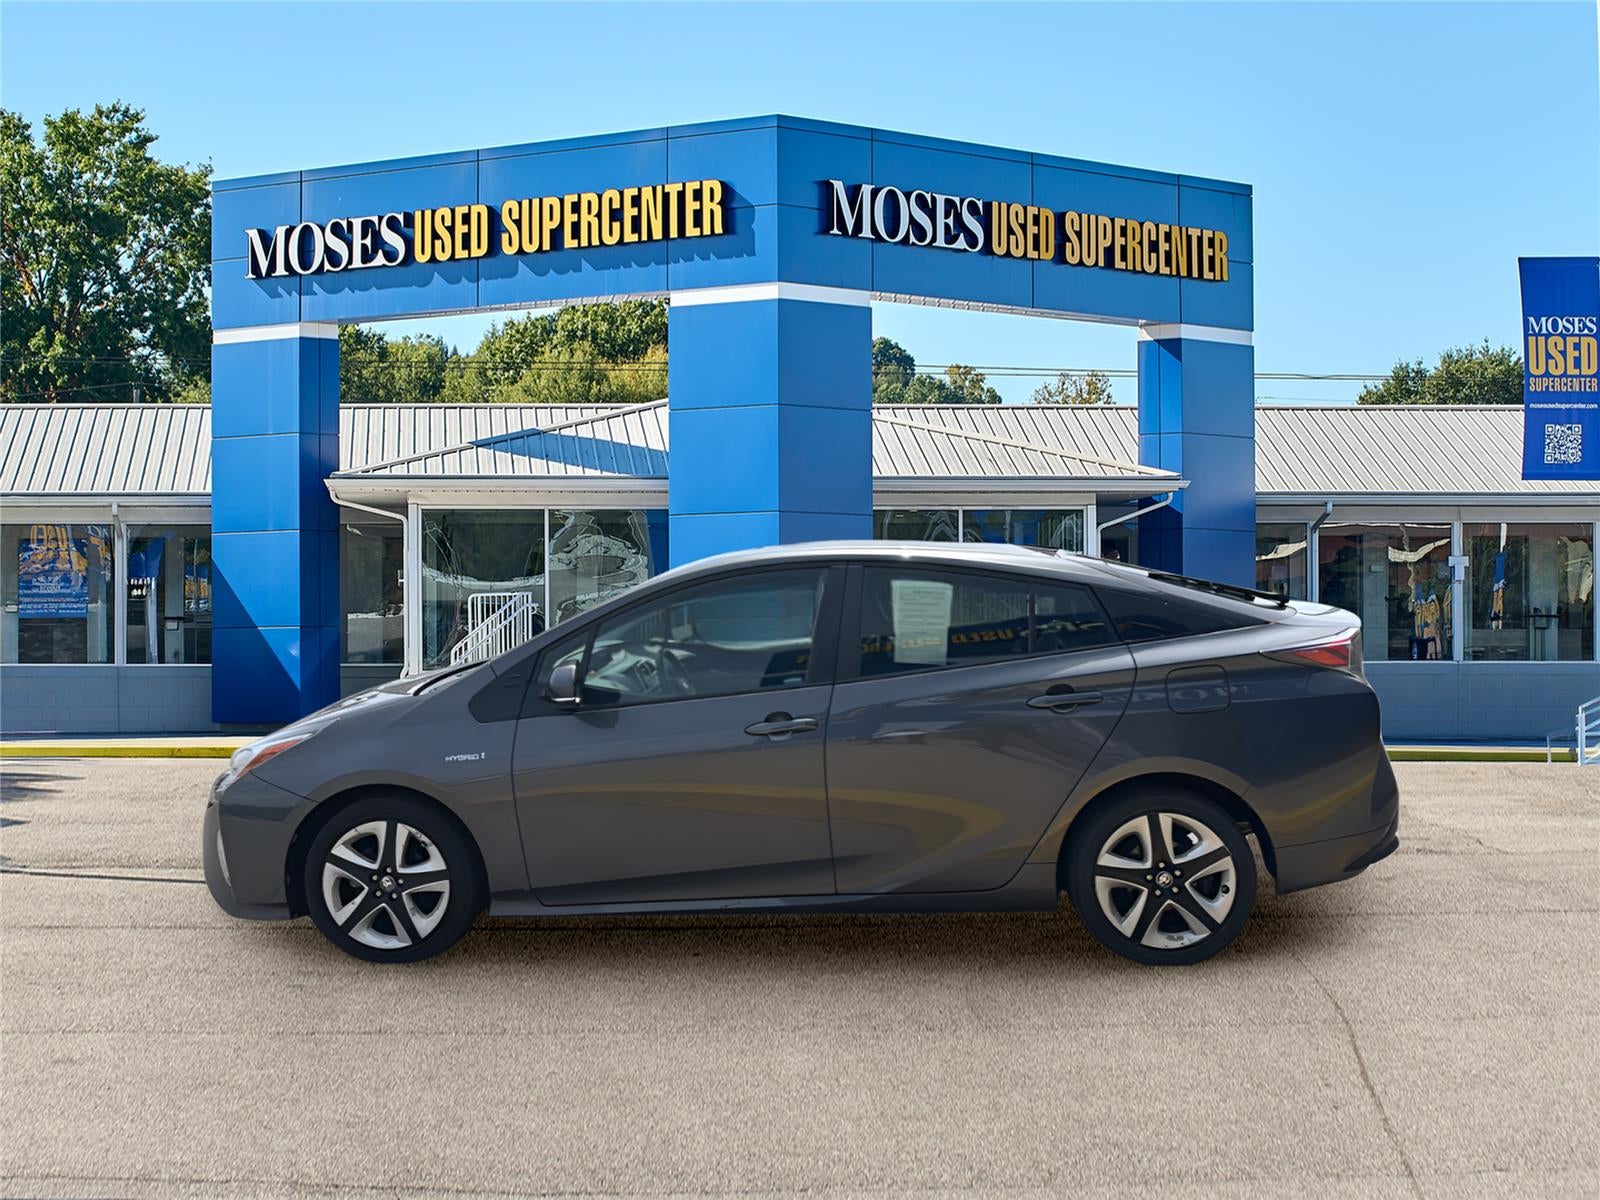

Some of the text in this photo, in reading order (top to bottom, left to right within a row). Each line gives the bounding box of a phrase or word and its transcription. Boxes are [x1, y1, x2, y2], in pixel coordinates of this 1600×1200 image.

[244, 179, 724, 279] MOSES USED SUPERCENTER
[828, 179, 1230, 282] MOSES USED SUPERCENTER
[1527, 316, 1597, 335] MOSES
[1528, 335, 1599, 376] USED
[1529, 377, 1599, 393] SUPERCENTER
